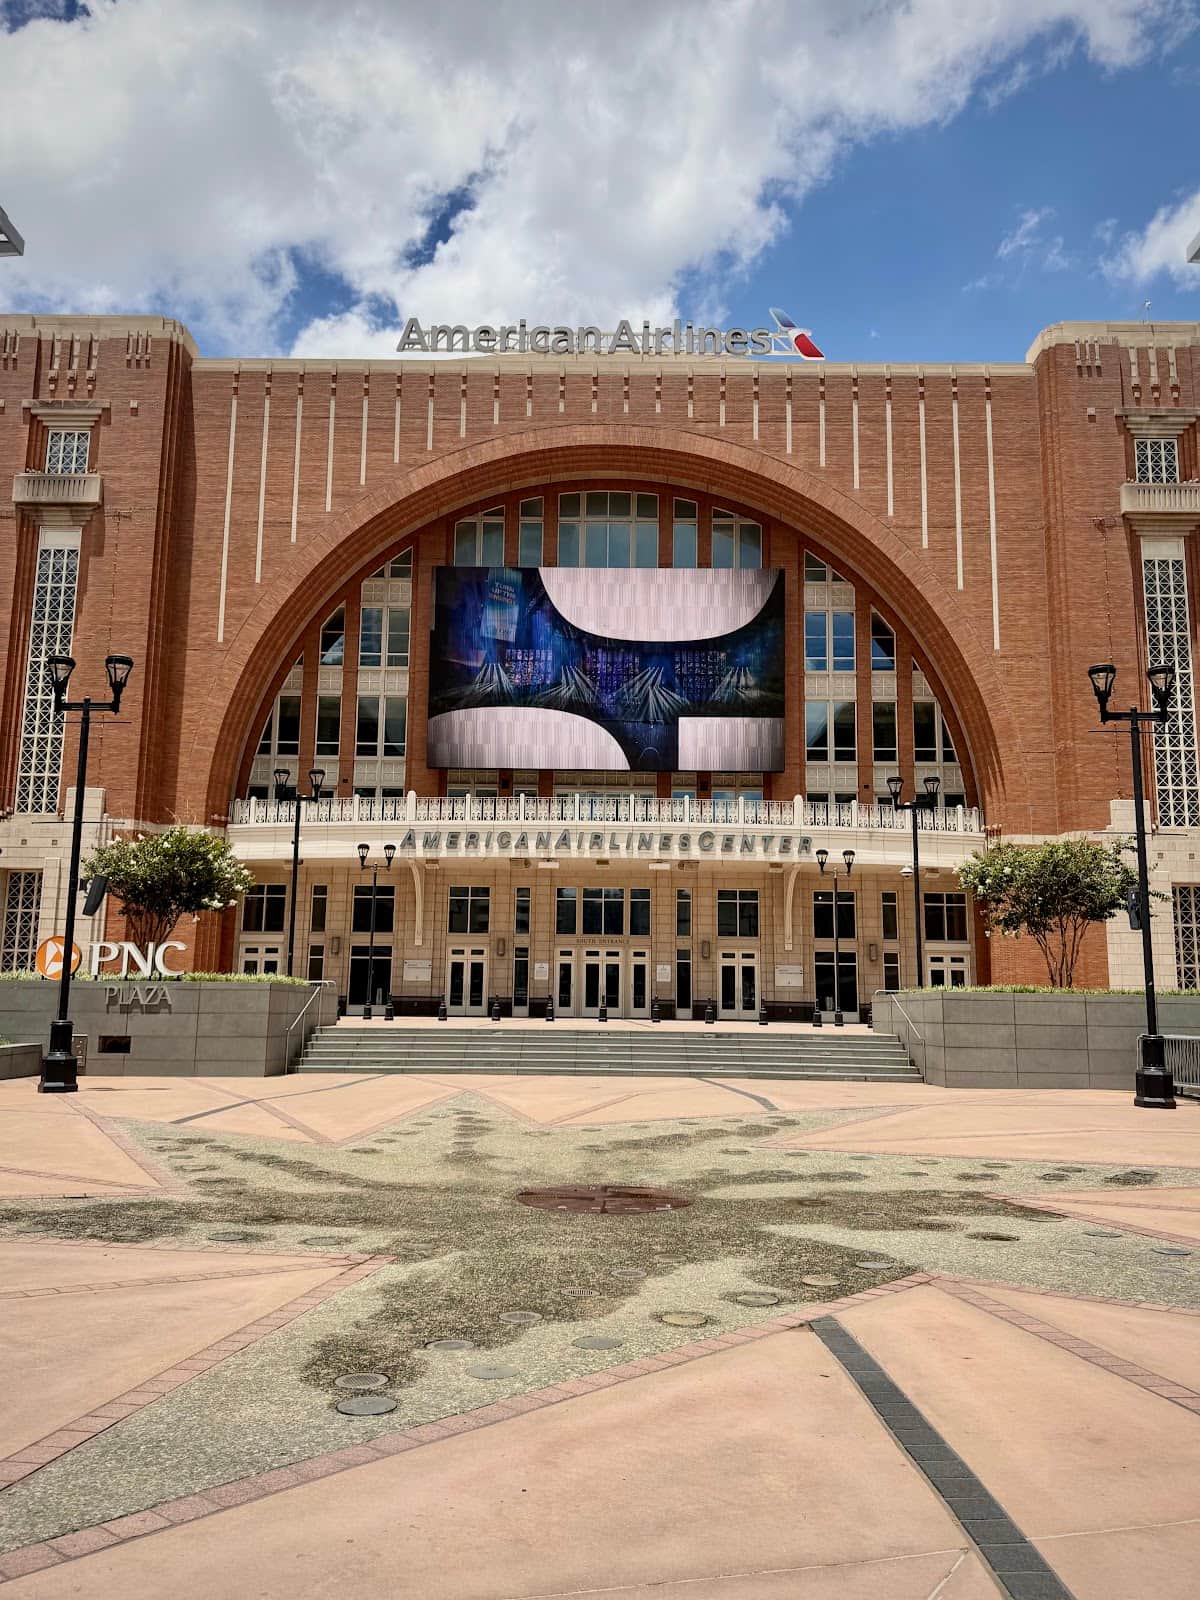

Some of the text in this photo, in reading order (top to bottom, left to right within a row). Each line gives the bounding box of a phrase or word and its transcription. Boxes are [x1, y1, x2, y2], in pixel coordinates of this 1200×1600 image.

[398, 317, 774, 355] American Airlines
[400, 829, 813, 854] AMERICAN AIRLINES CENTER
[90, 941, 187, 976] PNC
[106, 985, 173, 1005] PLAZA
